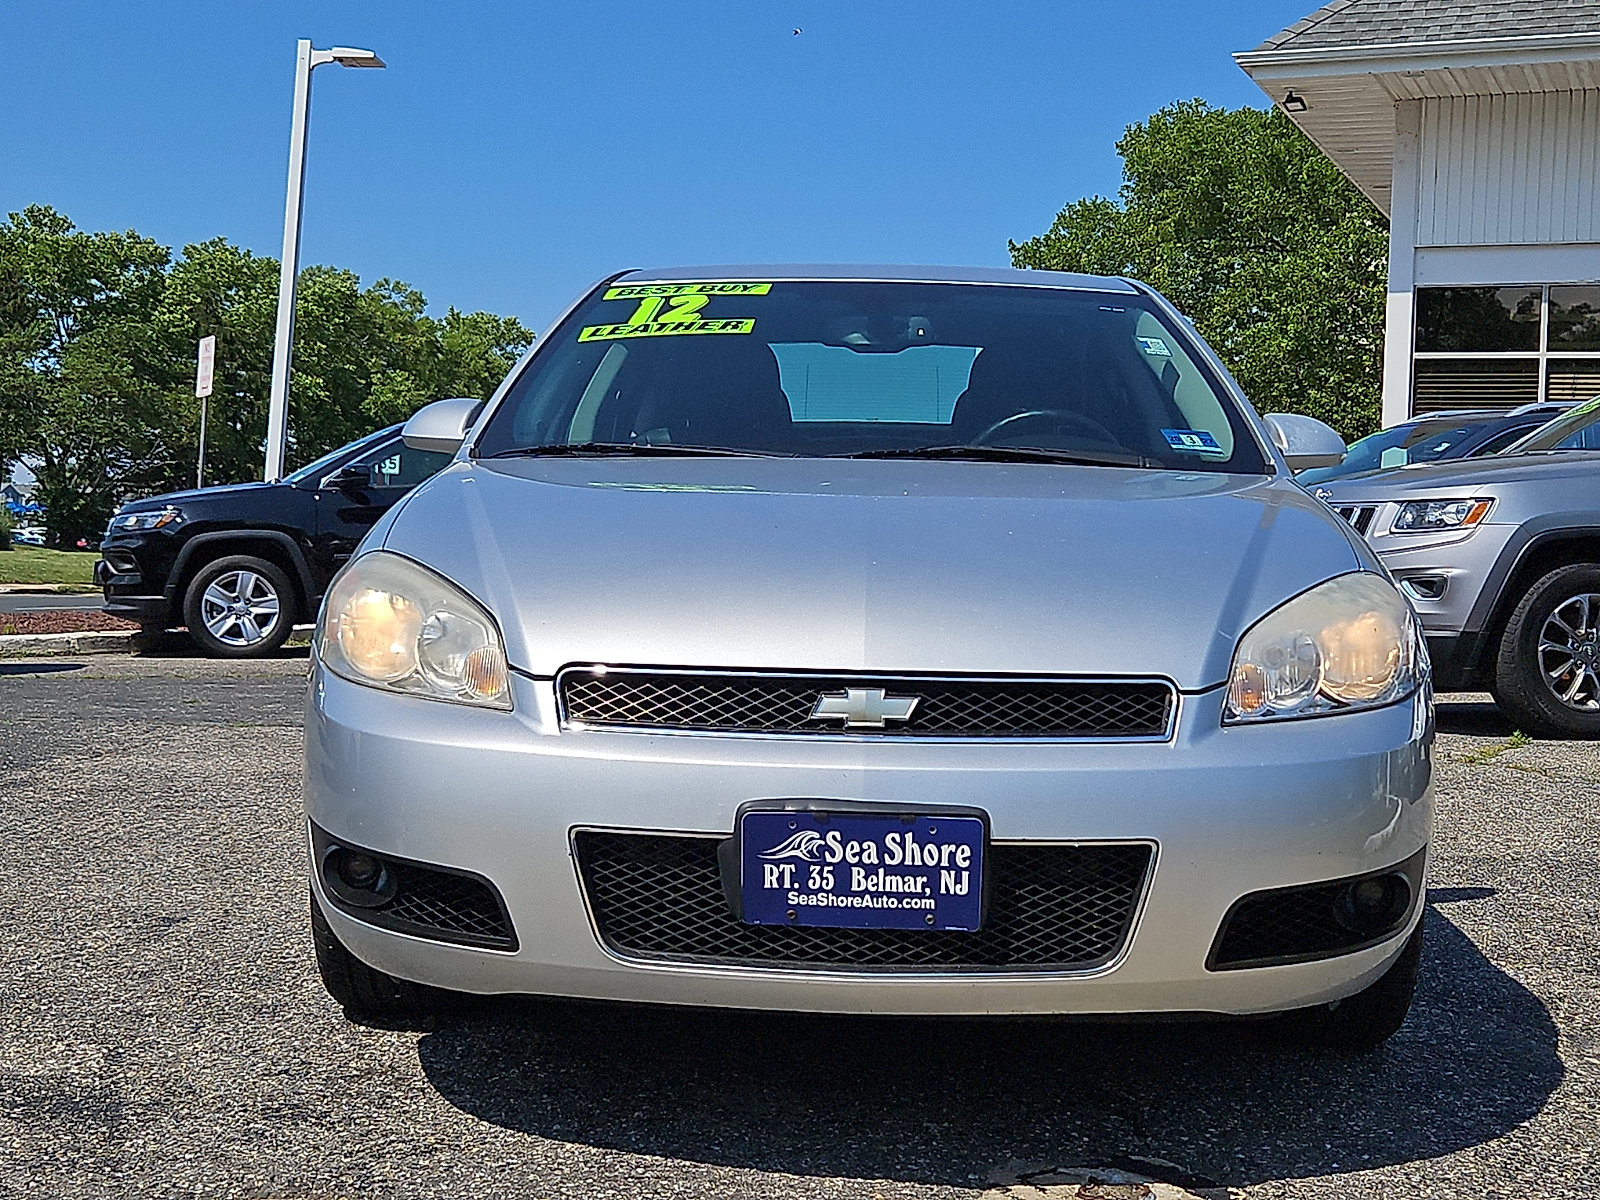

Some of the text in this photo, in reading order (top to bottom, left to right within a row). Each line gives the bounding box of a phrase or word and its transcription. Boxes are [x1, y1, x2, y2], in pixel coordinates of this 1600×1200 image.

[614, 284, 761, 297] BEST BUY
[627, 294, 710, 325] 12
[588, 320, 747, 338] LEATHER
[1186, 435, 1196, 444] 3
[825, 831, 971, 868] Sea Shore
[763, 864, 970, 896] RT. 35 Belmar, NJ
[787, 891, 935, 909] SeaShoreAuto.com
